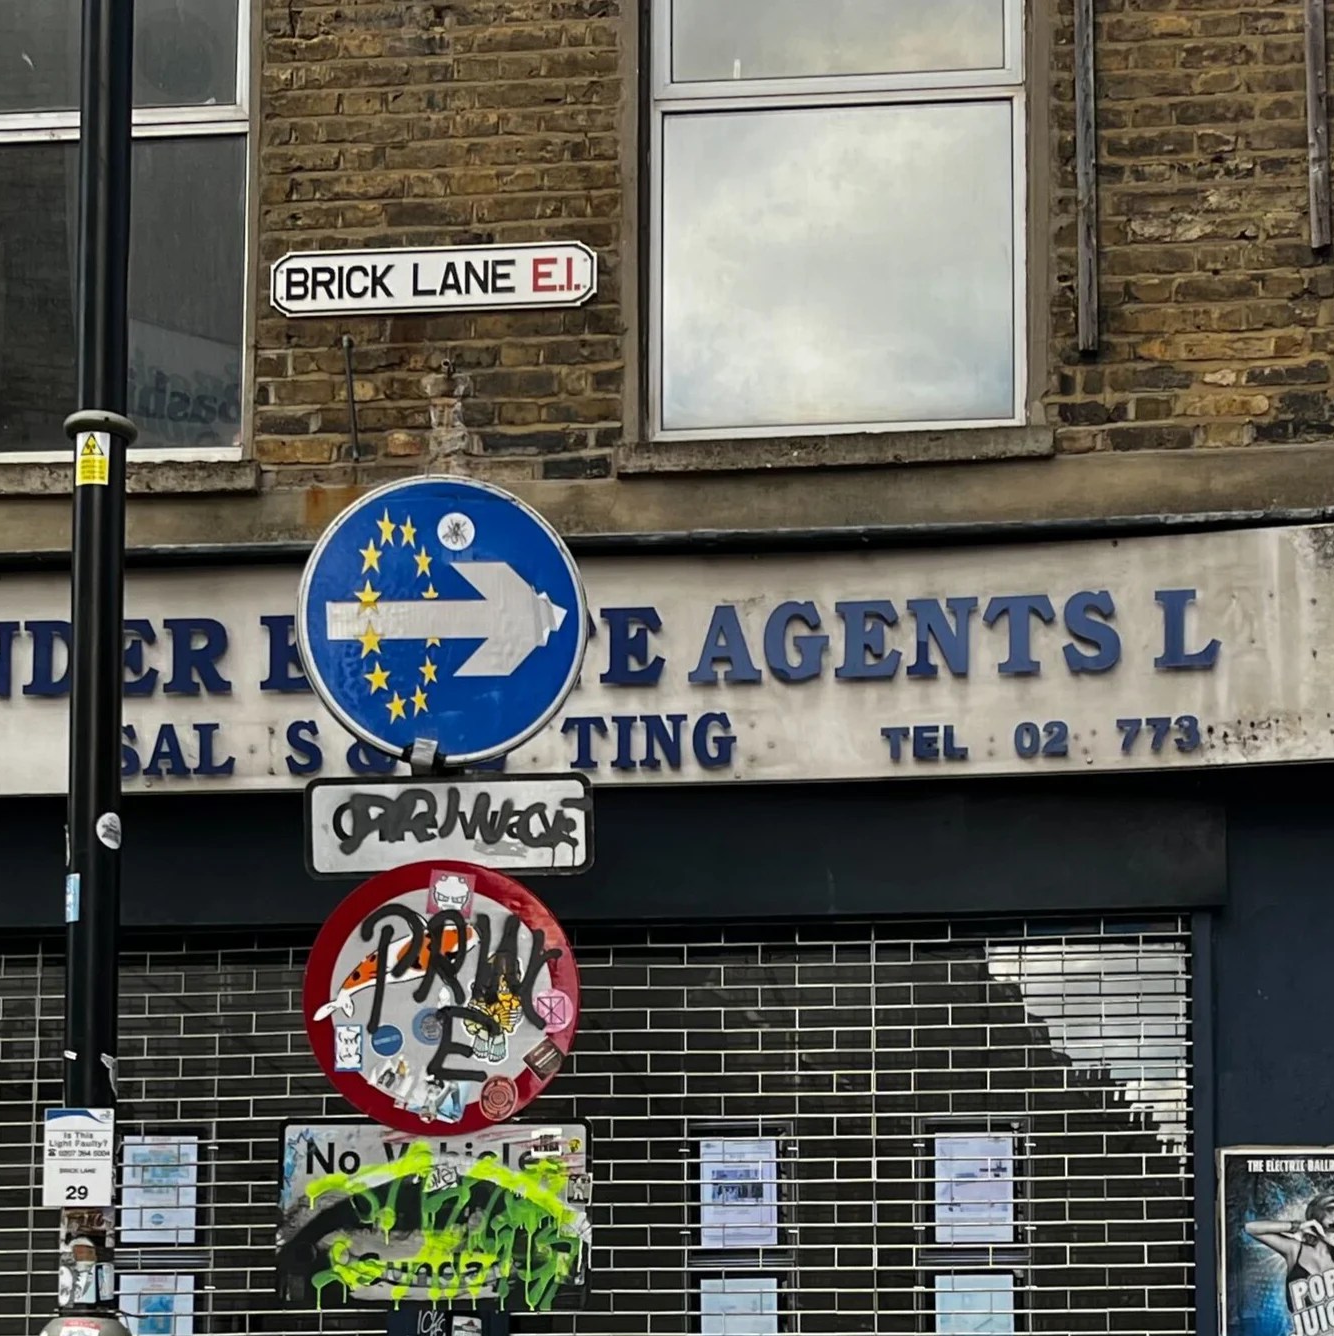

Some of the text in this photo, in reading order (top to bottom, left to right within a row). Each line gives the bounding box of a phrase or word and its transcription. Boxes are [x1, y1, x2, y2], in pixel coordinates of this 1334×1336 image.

[285, 264, 395, 301] BRICK
[411, 258, 516, 297] LANE
[687, 589, 1123, 685] AGENTS
[880, 713, 1202, 763] TEL 02 773
[49, 1140, 108, 1149] Light Faulty?
[63, 1132, 94, 1140] Is This
[305, 1141, 362, 1175] No
[1247, 1159, 1264, 1172] THE
[1266, 1158, 1306, 1172] ELECTRIC
[65, 1185, 89, 1200] 29
